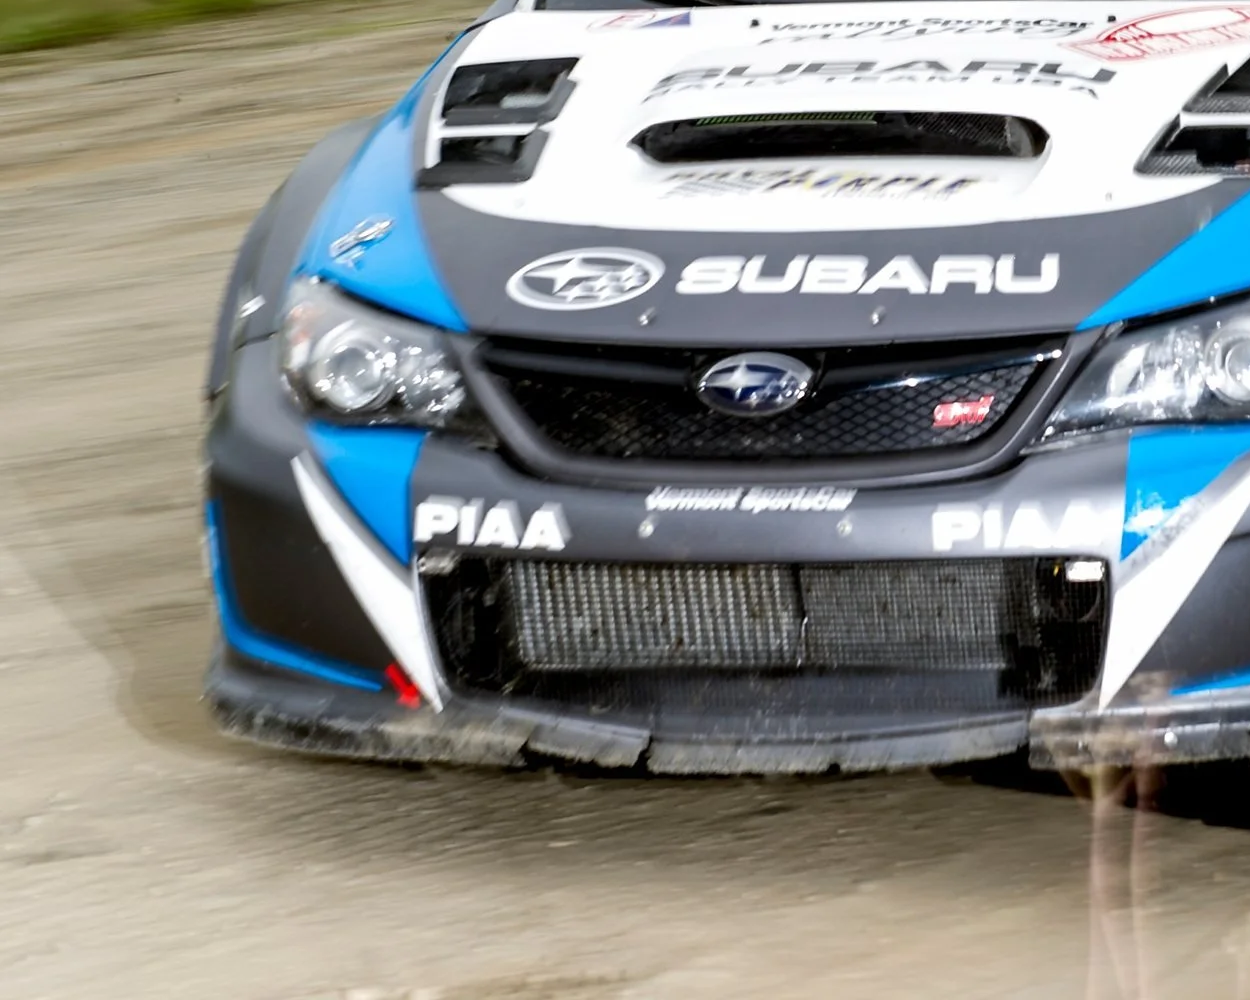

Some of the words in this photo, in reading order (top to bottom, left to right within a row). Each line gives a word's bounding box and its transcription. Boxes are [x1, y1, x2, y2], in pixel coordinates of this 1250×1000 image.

[650, 58, 1117, 88] SUBARU
[676, 253, 1060, 295] SUBARU
[413, 496, 571, 551] PIAA
[932, 501, 1106, 551] PIAA
